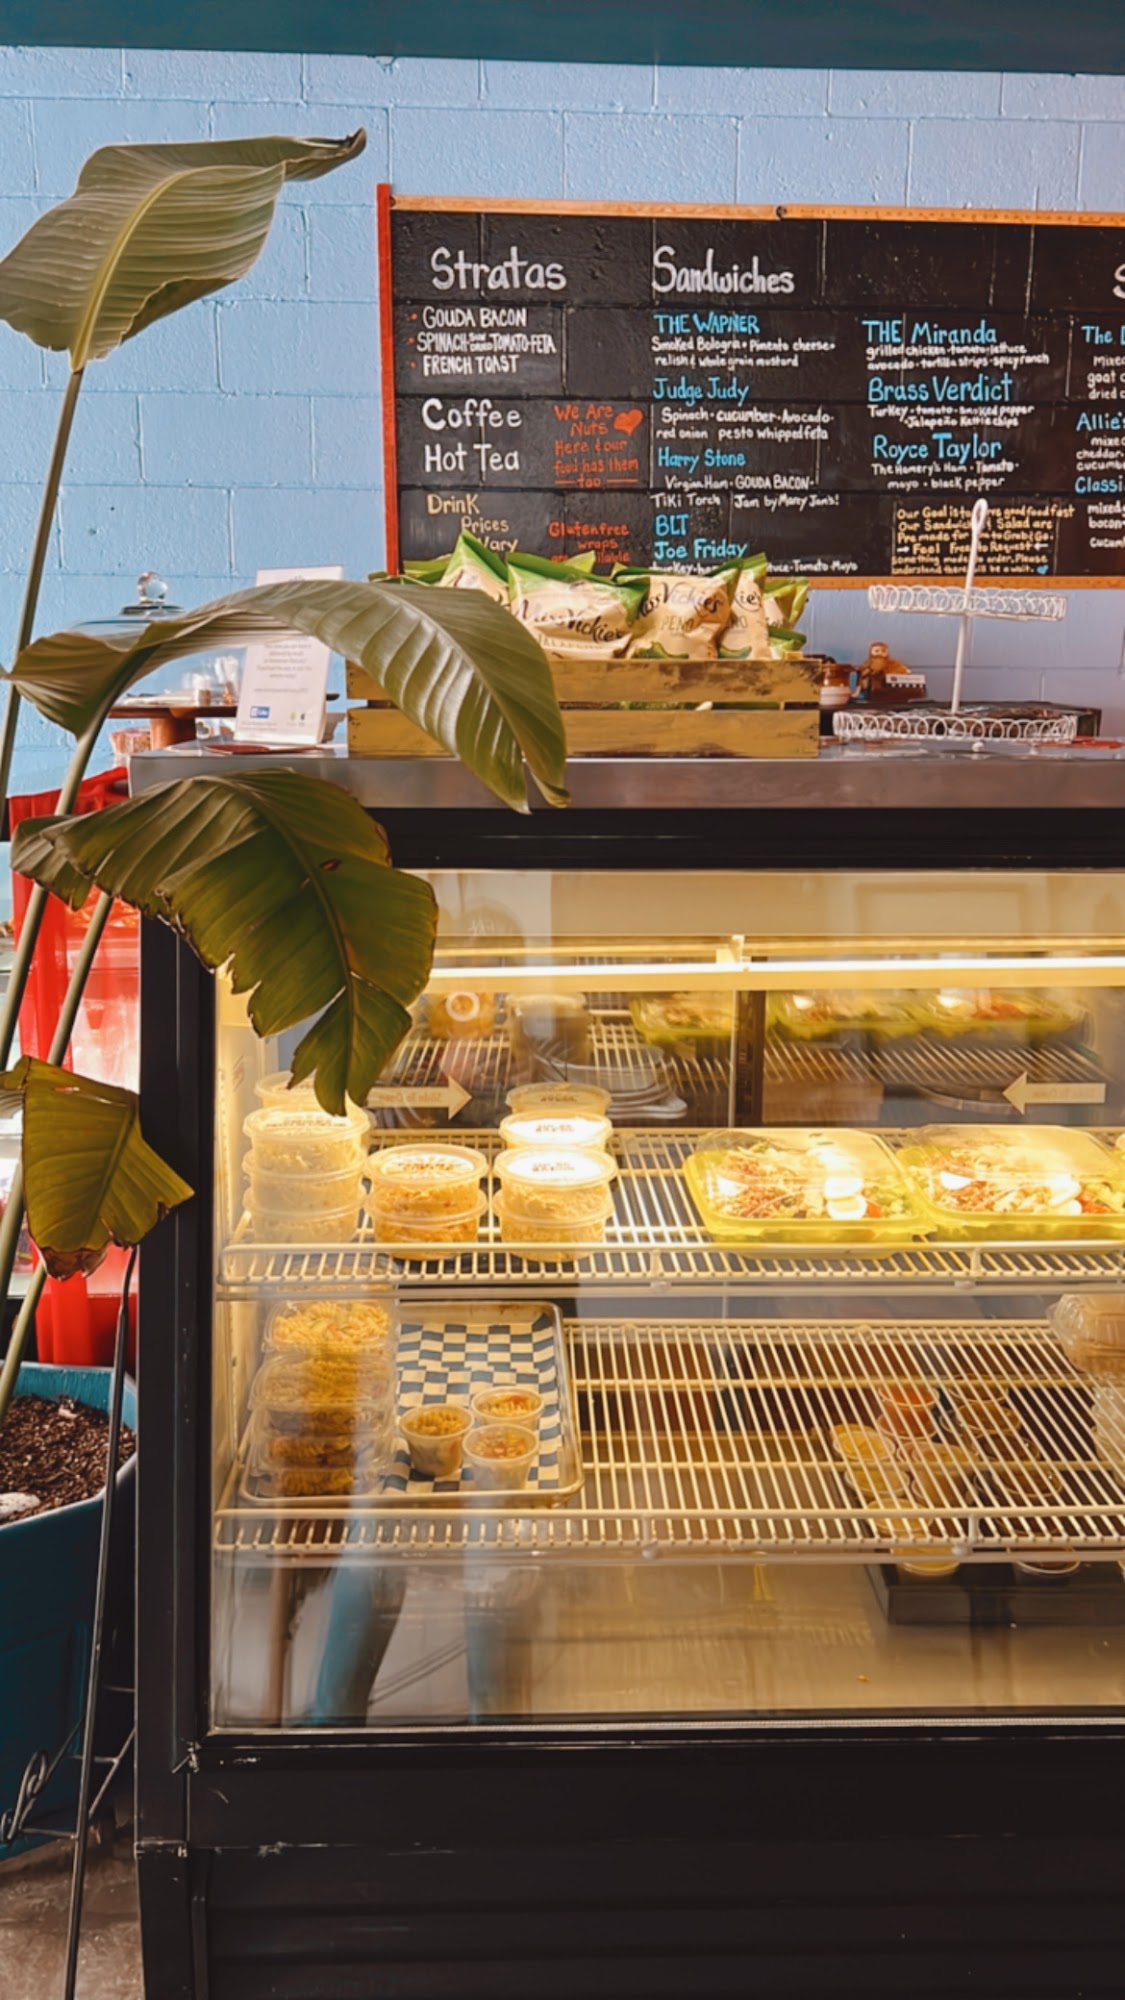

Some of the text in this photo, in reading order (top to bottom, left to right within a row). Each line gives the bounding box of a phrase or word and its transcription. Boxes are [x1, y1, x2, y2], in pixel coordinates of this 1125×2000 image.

[431, 246, 567, 290] Stratas
[652, 245, 795, 293] Sandwiches
[423, 306, 527, 328] GOUDA BACON
[653, 311, 760, 334] THE WAPNER
[862, 319, 997, 344] THE Miranda
[1081, 325, 1113, 344] The
[756, 353, 799, 367] mustard
[866, 343, 905, 361] grilled
[906, 344, 946, 357] chicken
[423, 354, 520, 376] FRENCH TOAST
[867, 357, 915, 371] avocado
[993, 355, 1020, 371] spicy
[868, 372, 1012, 402] Brass Verdict
[1087, 370, 1116, 388] goat
[653, 376, 750, 407] Judge Judy
[1088, 386, 1117, 399] dried
[422, 398, 522, 430] Coffee
[554, 404, 613, 421] We Are
[999, 404, 1035, 418] pepper
[570, 421, 609, 437] Nuts
[656, 427, 676, 439] red
[678, 426, 708, 440] onion
[718, 425, 754, 442] pesto
[756, 425, 803, 443] whipped
[555, 439, 588, 456] Here
[603, 440, 627, 452] our
[873, 432, 1002, 464] Royce Taylor
[425, 442, 519, 472] Hot Tea
[582, 458, 605, 473] has
[609, 457, 639, 472] them
[658, 446, 746, 473] Harry Stone
[871, 463, 894, 476] The
[577, 474, 602, 488] too
[735, 475, 772, 490] GOUDA
[887, 480, 919, 492] mayo
[964, 477, 1005, 492] pepper
[686, 492, 721, 507] Torch
[734, 494, 760, 509] Jam
[896, 508, 919, 520] Our
[922, 504, 947, 518] Goal
[461, 516, 510, 534] Prices
[655, 514, 690, 536] BLT
[898, 521, 920, 532] Our
[996, 516, 1030, 530] Salad
[1032, 520, 1054, 530] are
[918, 531, 950, 541] made
[577, 538, 619, 552] wraps
[654, 538, 749, 559] Joe Friday
[912, 542, 940, 555] Feel
